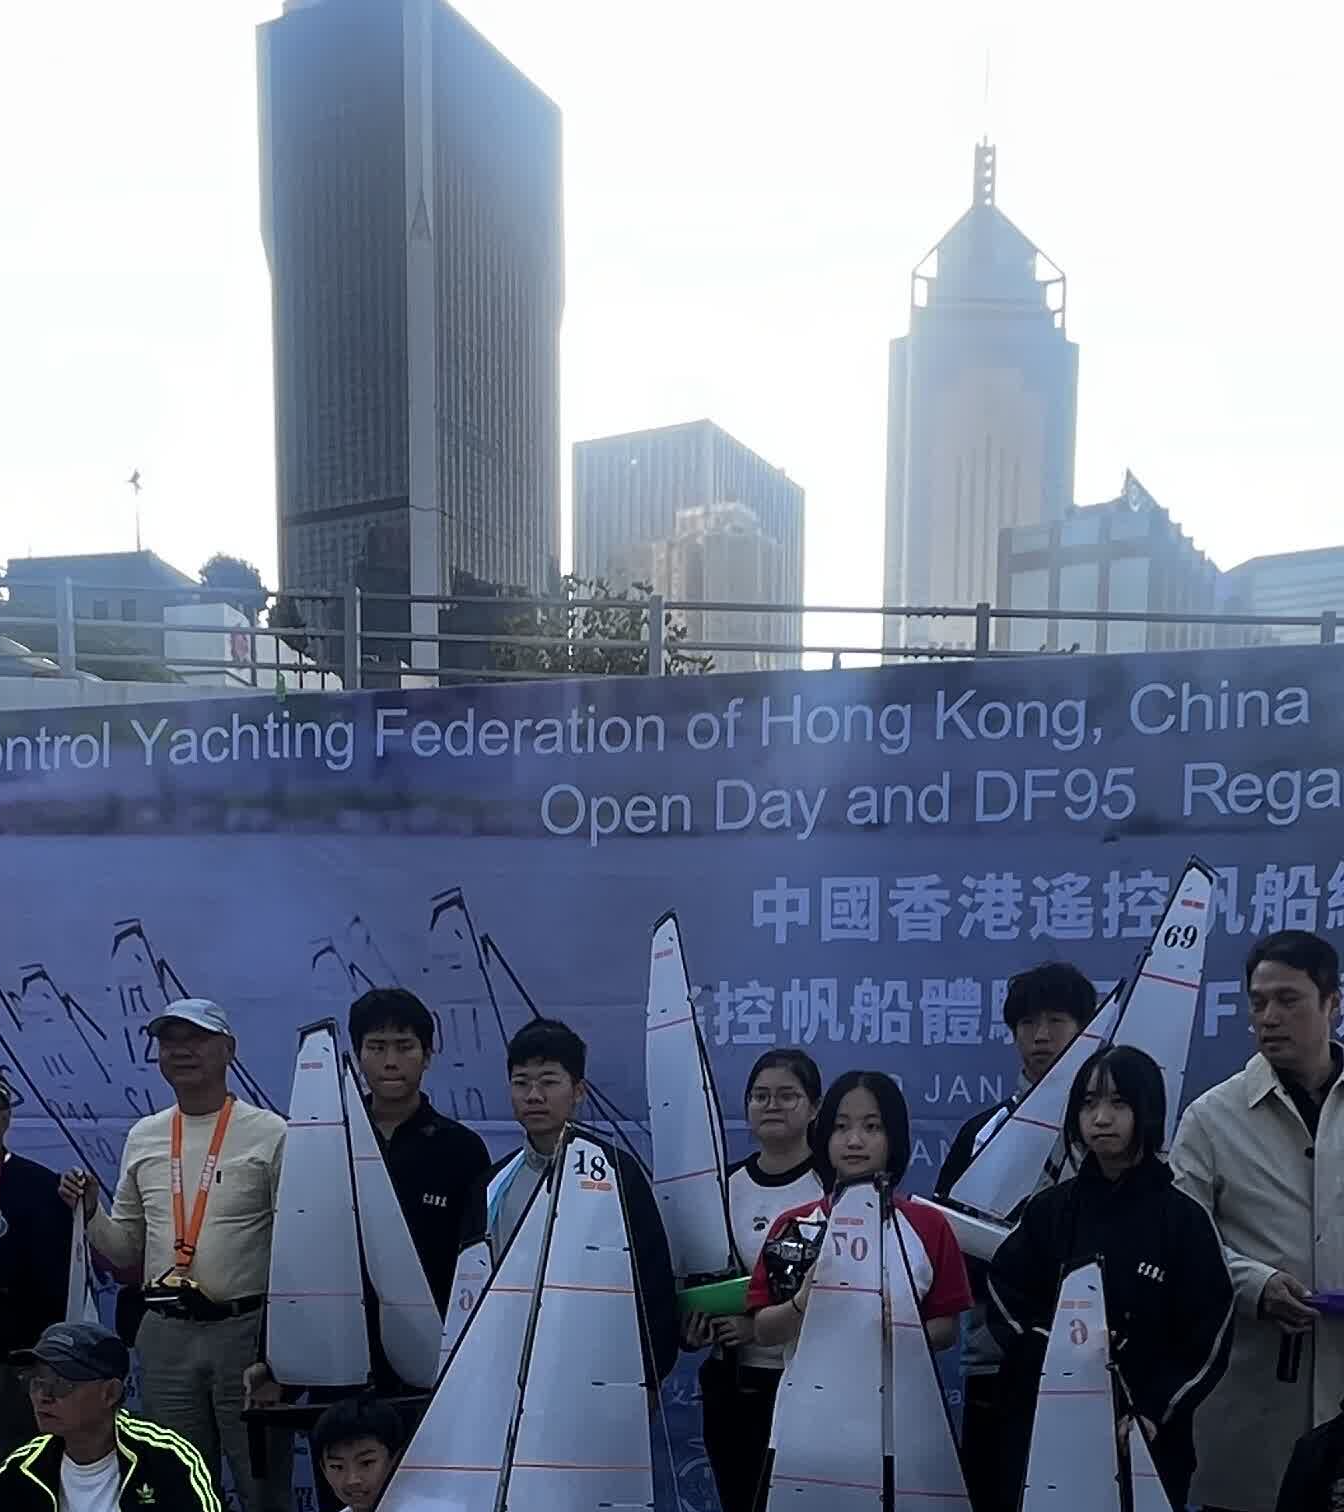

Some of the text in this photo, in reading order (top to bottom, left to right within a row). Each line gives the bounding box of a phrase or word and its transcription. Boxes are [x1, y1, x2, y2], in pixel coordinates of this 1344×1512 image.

[131, 711, 355, 772] Yachting
[376, 702, 665, 758] Federation
[687, 697, 740, 751] of
[761, 693, 911, 755] Hong
[935, 687, 1102, 748] Kong,
[1129, 681, 1311, 736] China
[540, 782, 691, 847] Open
[715, 778, 827, 840] Day
[846, 772, 949, 826] and
[975, 766, 1137, 823] DF95
[1163, 924, 1198, 950] 69
[923, 1073, 1003, 1104] JAN
[573, 1149, 607, 1183] 18
